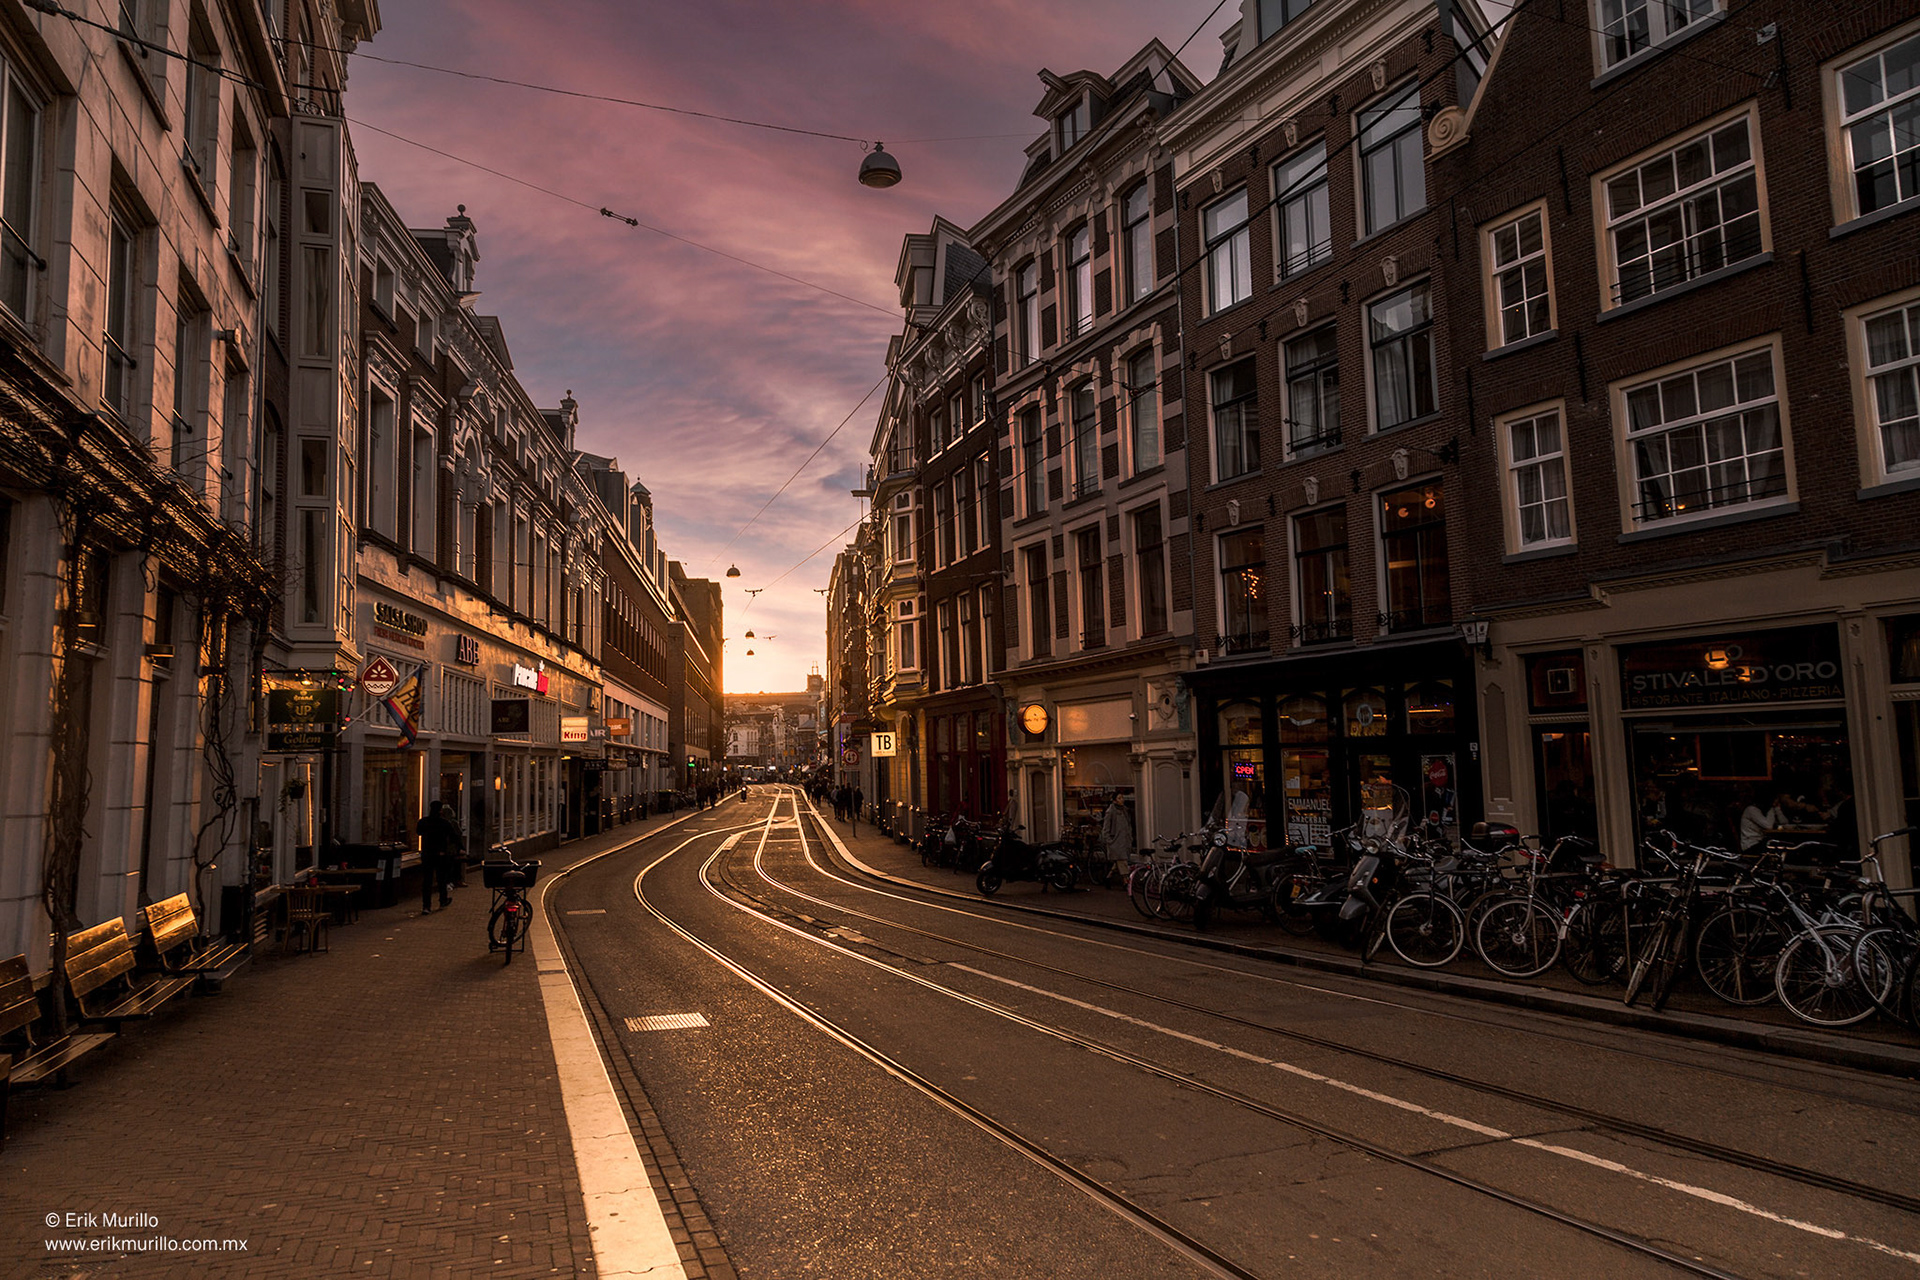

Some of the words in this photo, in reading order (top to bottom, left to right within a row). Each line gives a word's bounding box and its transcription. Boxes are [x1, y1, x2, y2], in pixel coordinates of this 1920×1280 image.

[374, 601, 404, 629] SALSA
[403, 611, 428, 636] SHOP
[459, 634, 479, 666] ABE
[1708, 644, 1743, 662] LO
[1632, 668, 1738, 691] STIVALE
[1750, 661, 1837, 684] D'ORO
[1632, 692, 1703, 706] RISTORANTE
[1709, 688, 1770, 703] ITALIANO
[1779, 685, 1842, 700] PIZZERIA
[296, 705, 312, 716] UP
[284, 733, 321, 744] Gollem
[564, 731, 586, 740] King
[876, 735, 891, 750] TB
[1236, 766, 1254, 775] OPEN
[1288, 797, 1331, 811] EMMANUEL
[1291, 815, 1327, 824] SNACKBAR
